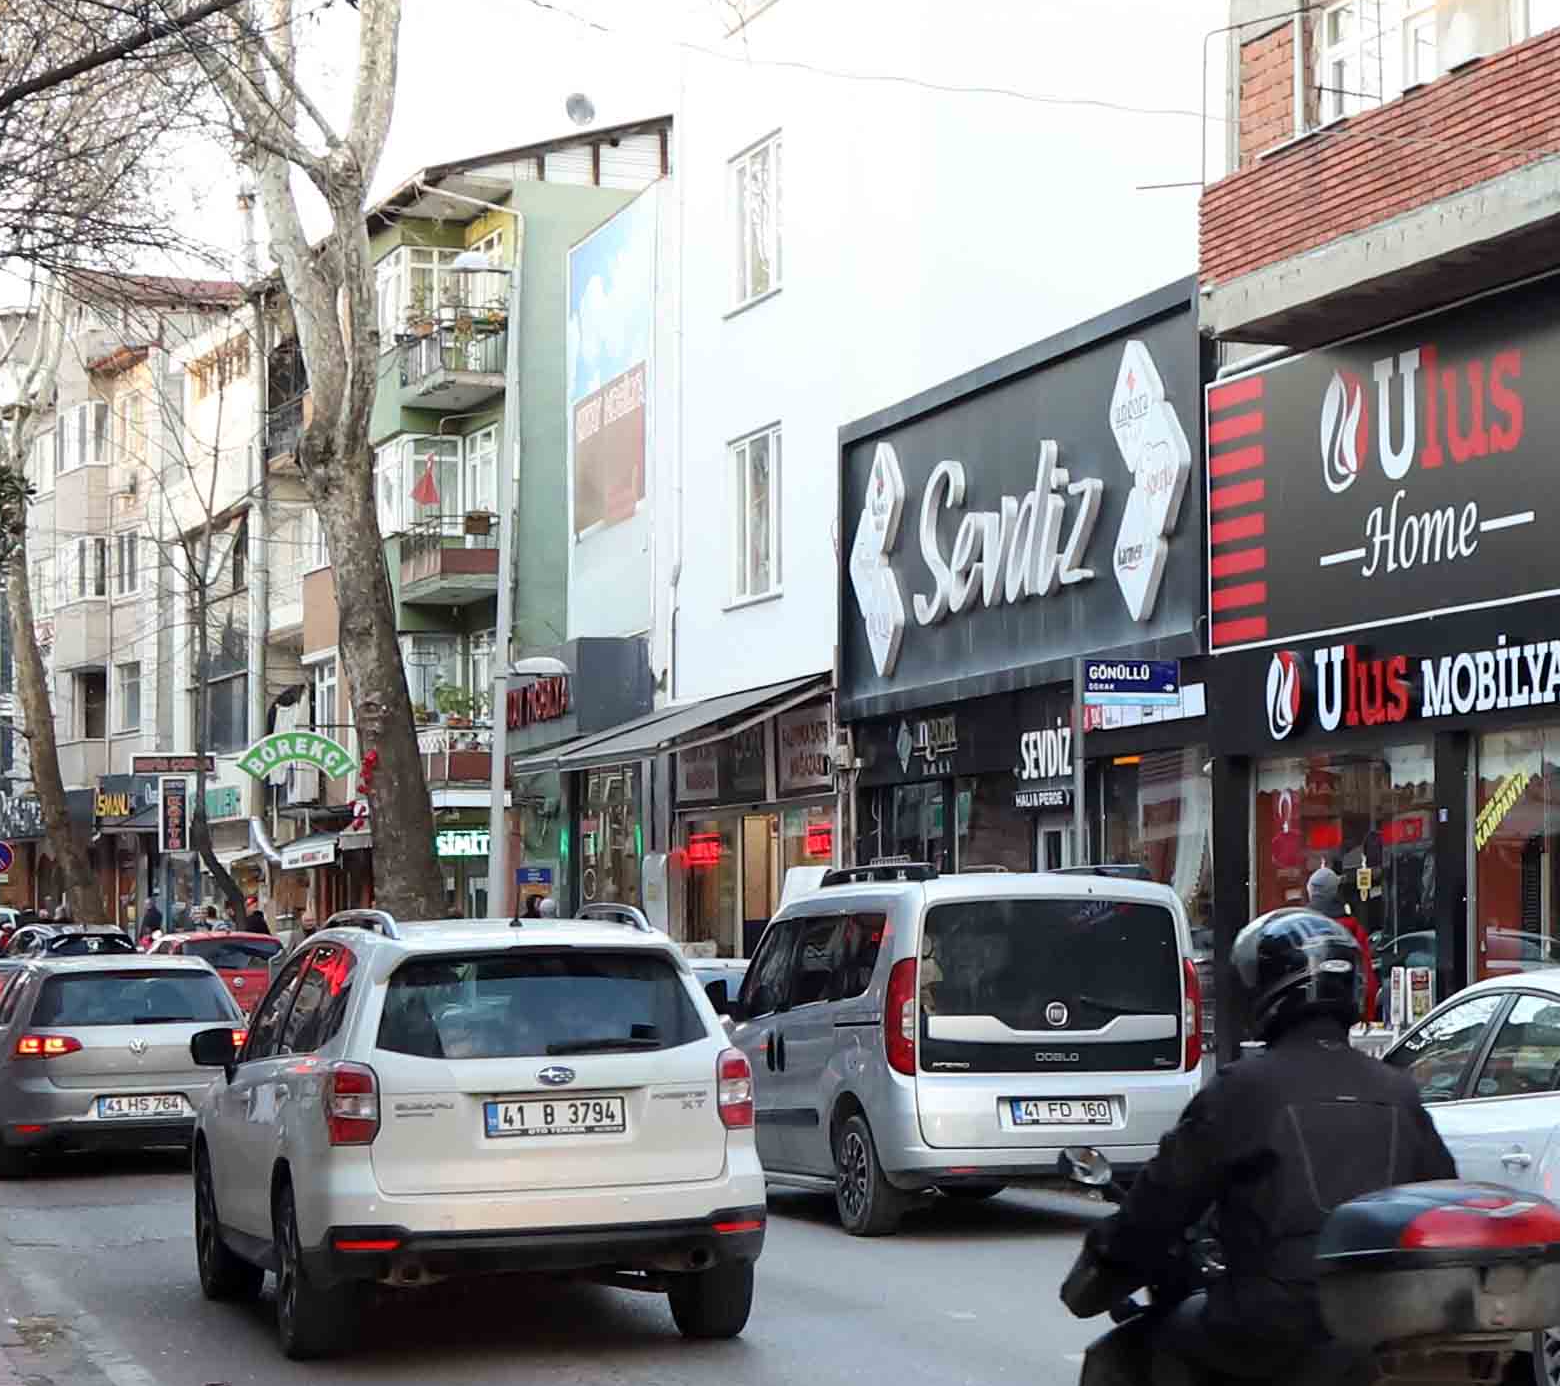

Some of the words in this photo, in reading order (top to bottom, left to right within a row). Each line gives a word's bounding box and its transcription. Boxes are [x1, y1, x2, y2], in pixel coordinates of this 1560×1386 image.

[1372, 344, 1524, 481] Ulus
[913, 440, 1104, 626] Sevdiz
[1361, 489, 1479, 578] Home
[1089, 663, 1150, 681] GÖNÜLLÜ
[1314, 644, 1410, 732] Ulus
[1020, 717, 1072, 781] SEVDİZ
[106, 1098, 122, 1112] 41
[128, 1097, 150, 1111] HS
[502, 1104, 526, 1128] 41
[543, 1103, 555, 1126] B
[568, 1101, 616, 1125] 3794
[1023, 1103, 1040, 1118] 41
[1047, 1102, 1072, 1118] FD
[1081, 1102, 1107, 1118] 160
